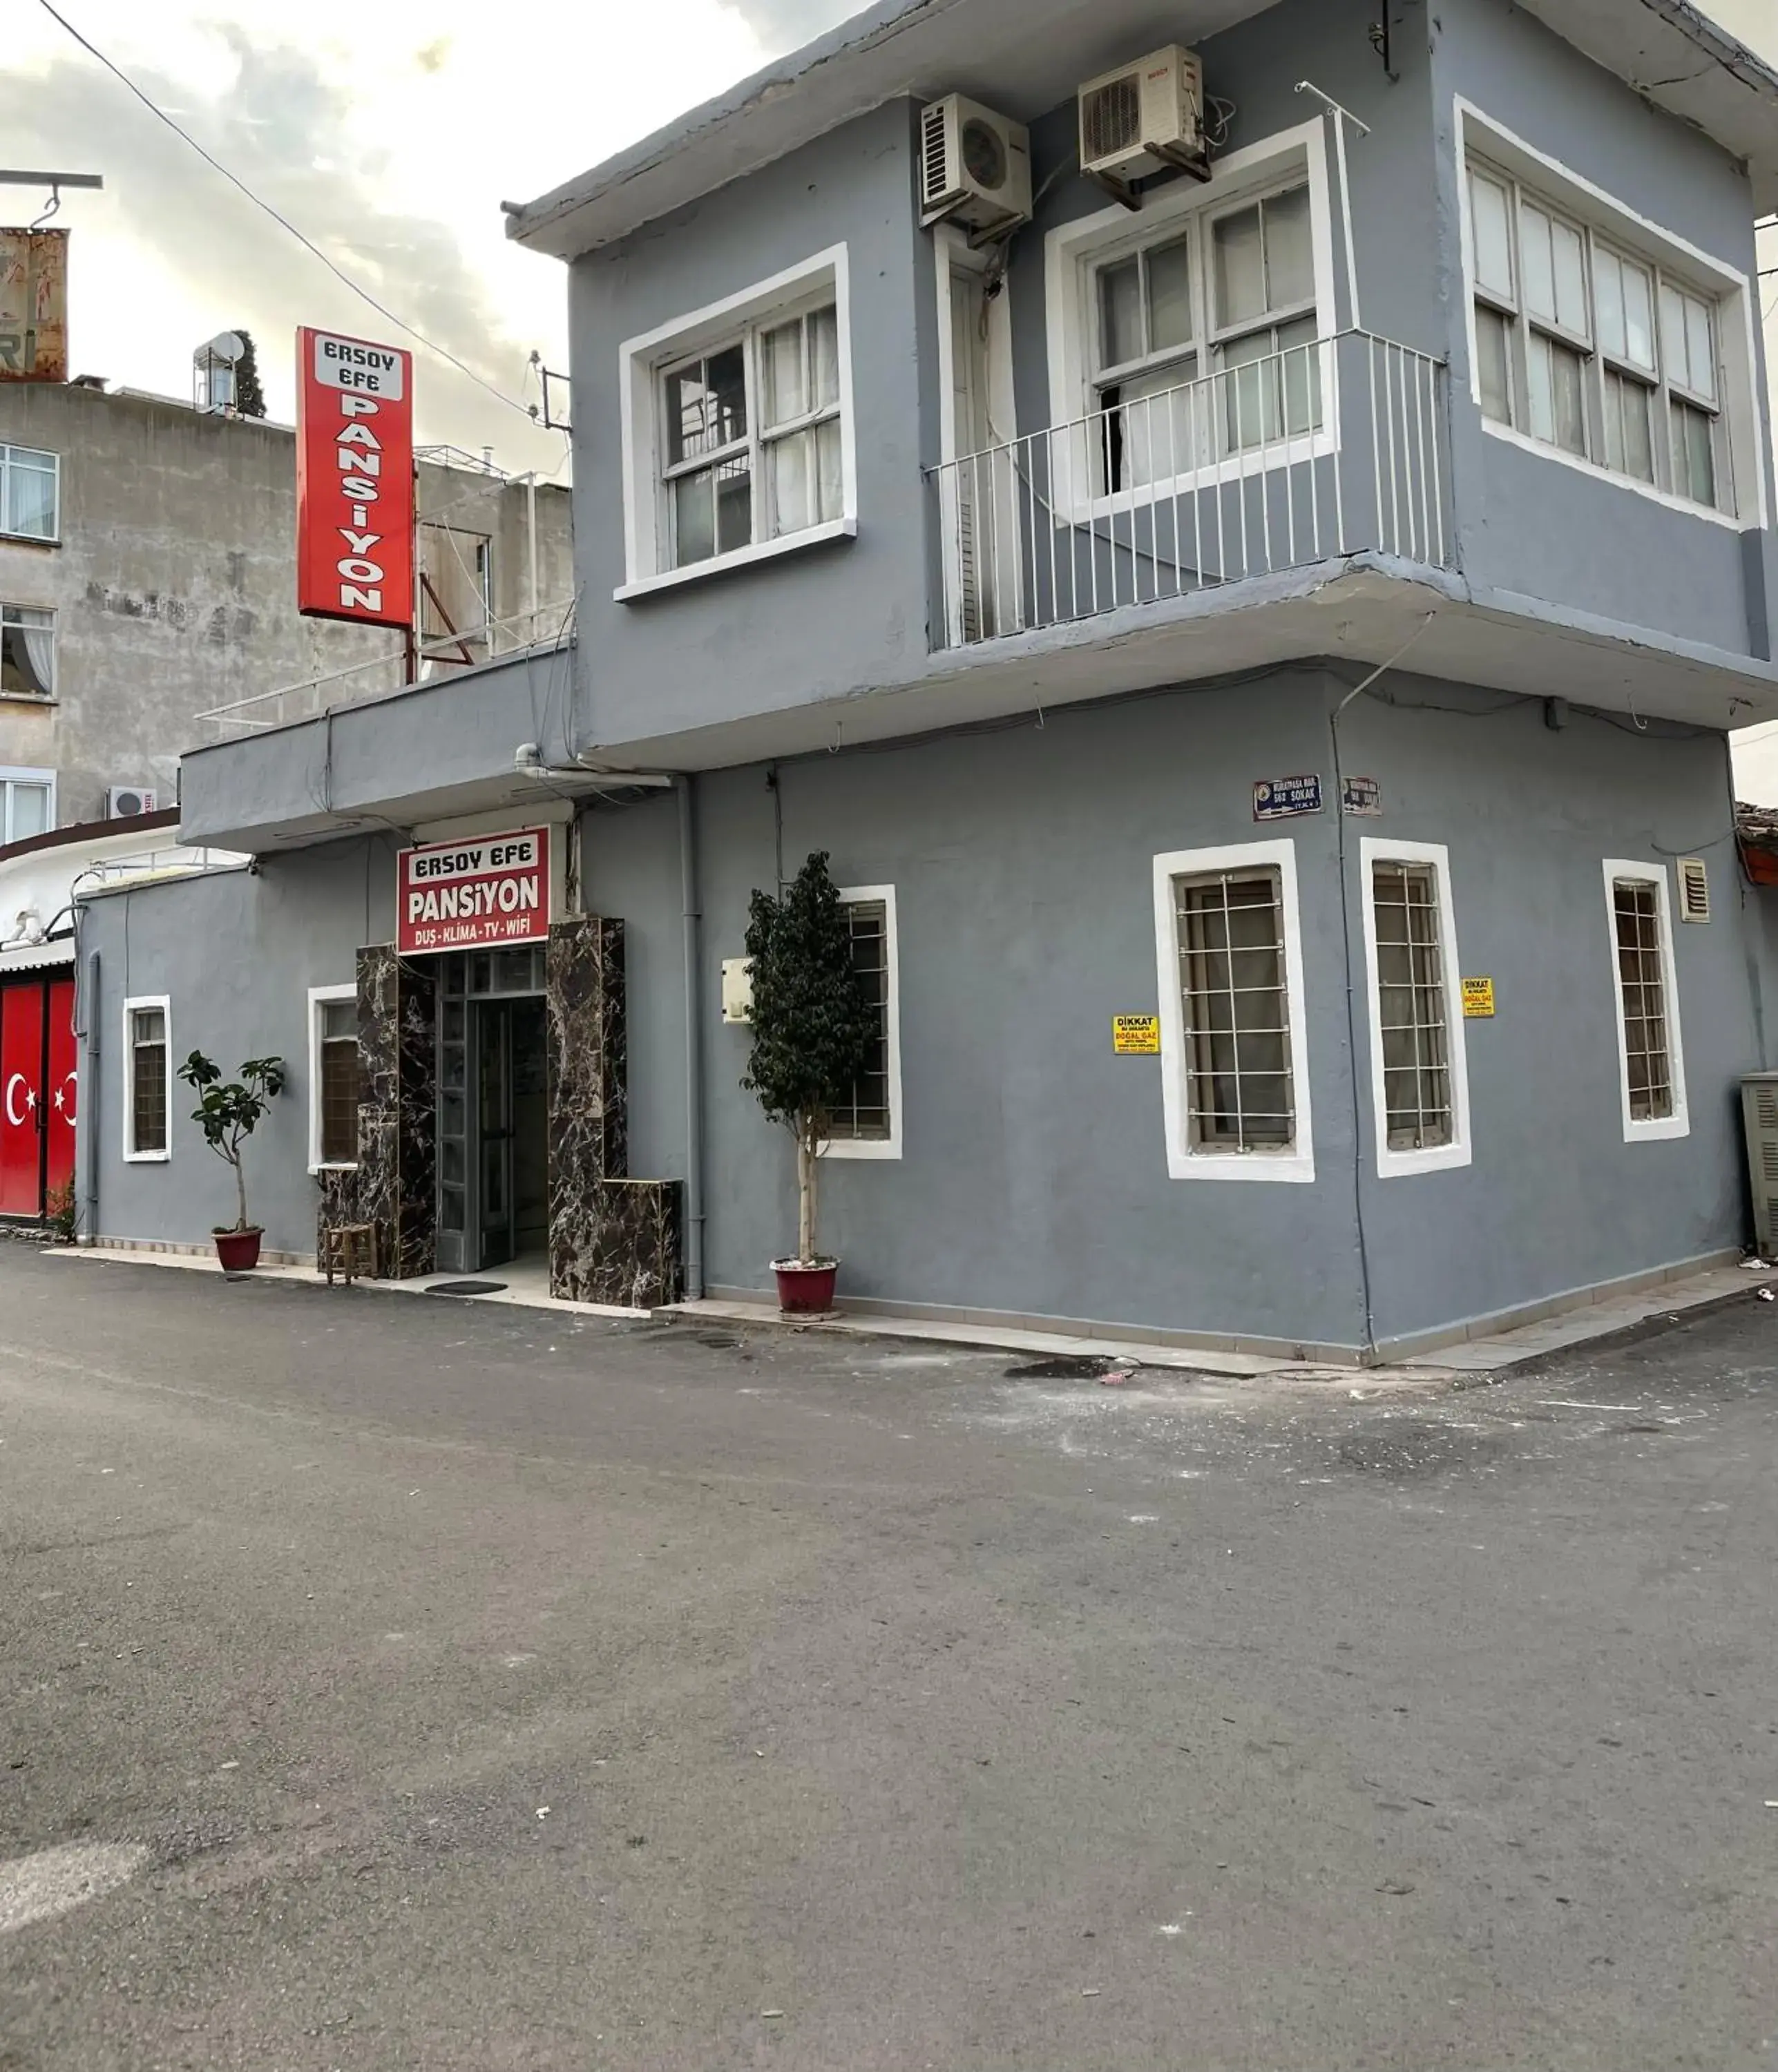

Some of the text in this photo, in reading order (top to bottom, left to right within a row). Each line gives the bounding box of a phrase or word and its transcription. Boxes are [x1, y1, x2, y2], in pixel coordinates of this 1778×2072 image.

[324, 341, 395, 372] ERSOY
[338, 368, 380, 392] EFE
[1290, 787, 1316, 802] SOKAK
[415, 842, 532, 877] ERSOY EFE
[415, 929, 437, 948] DUŞ
[443, 921, 477, 943] KLİMA
[484, 921, 500, 938] TV
[1117, 1016, 1154, 1026] DİKKAT
[1116, 1031, 1157, 1039] DOĞAL GAZ
